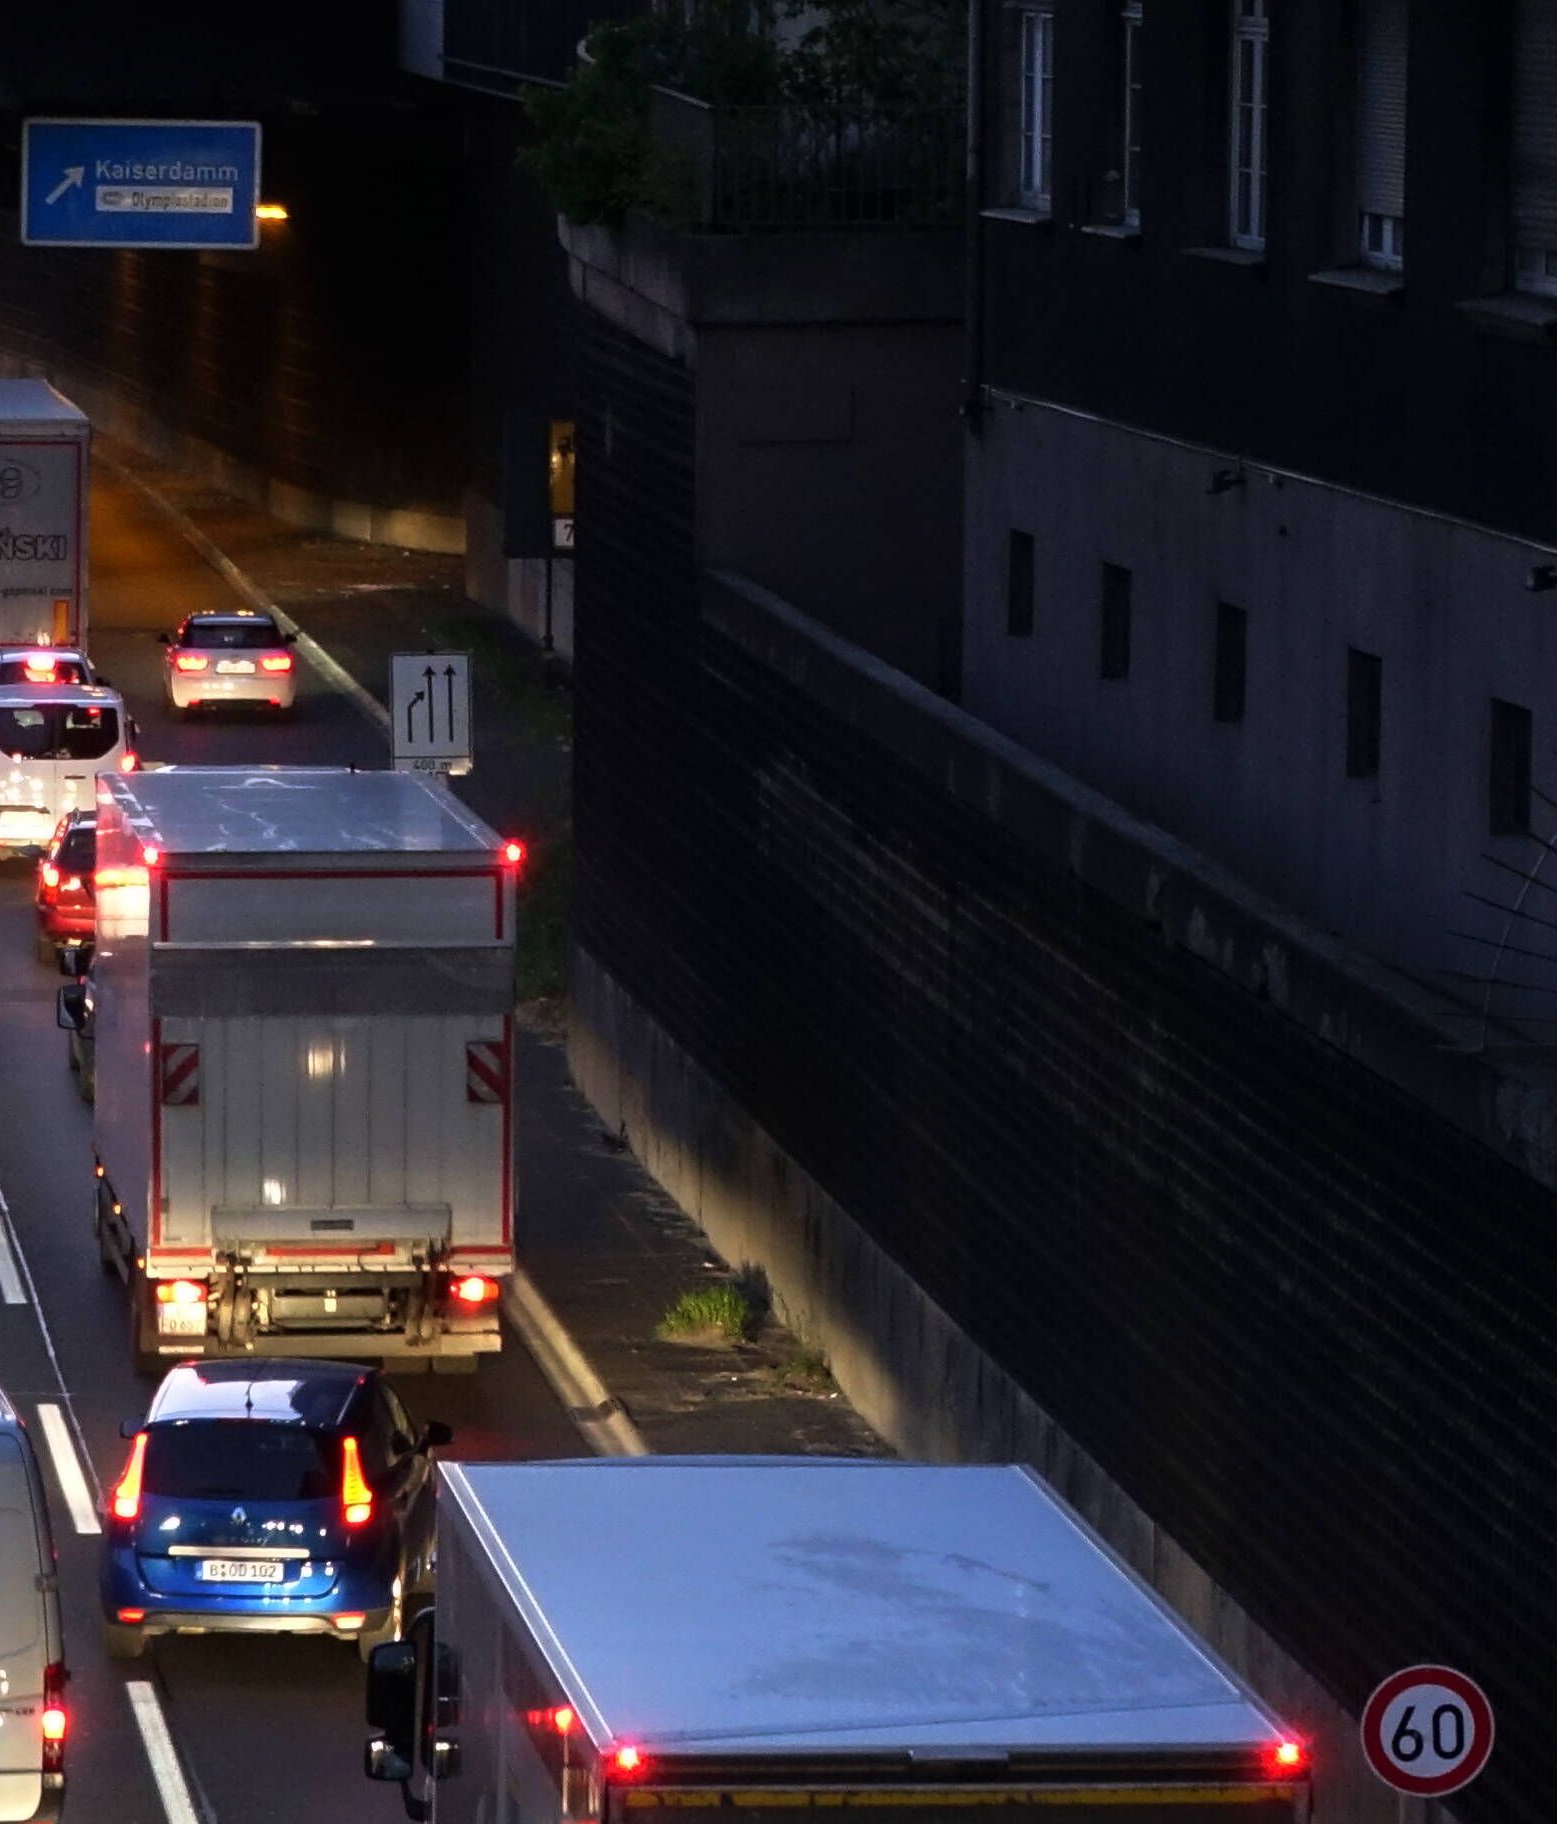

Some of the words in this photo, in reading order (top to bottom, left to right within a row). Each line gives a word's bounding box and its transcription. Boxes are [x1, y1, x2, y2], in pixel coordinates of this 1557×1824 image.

[96, 159, 239, 181] Kaiserdamm
[132, 190, 229, 210] Olympiastadion
[1391, 1704, 1465, 1763] 60
